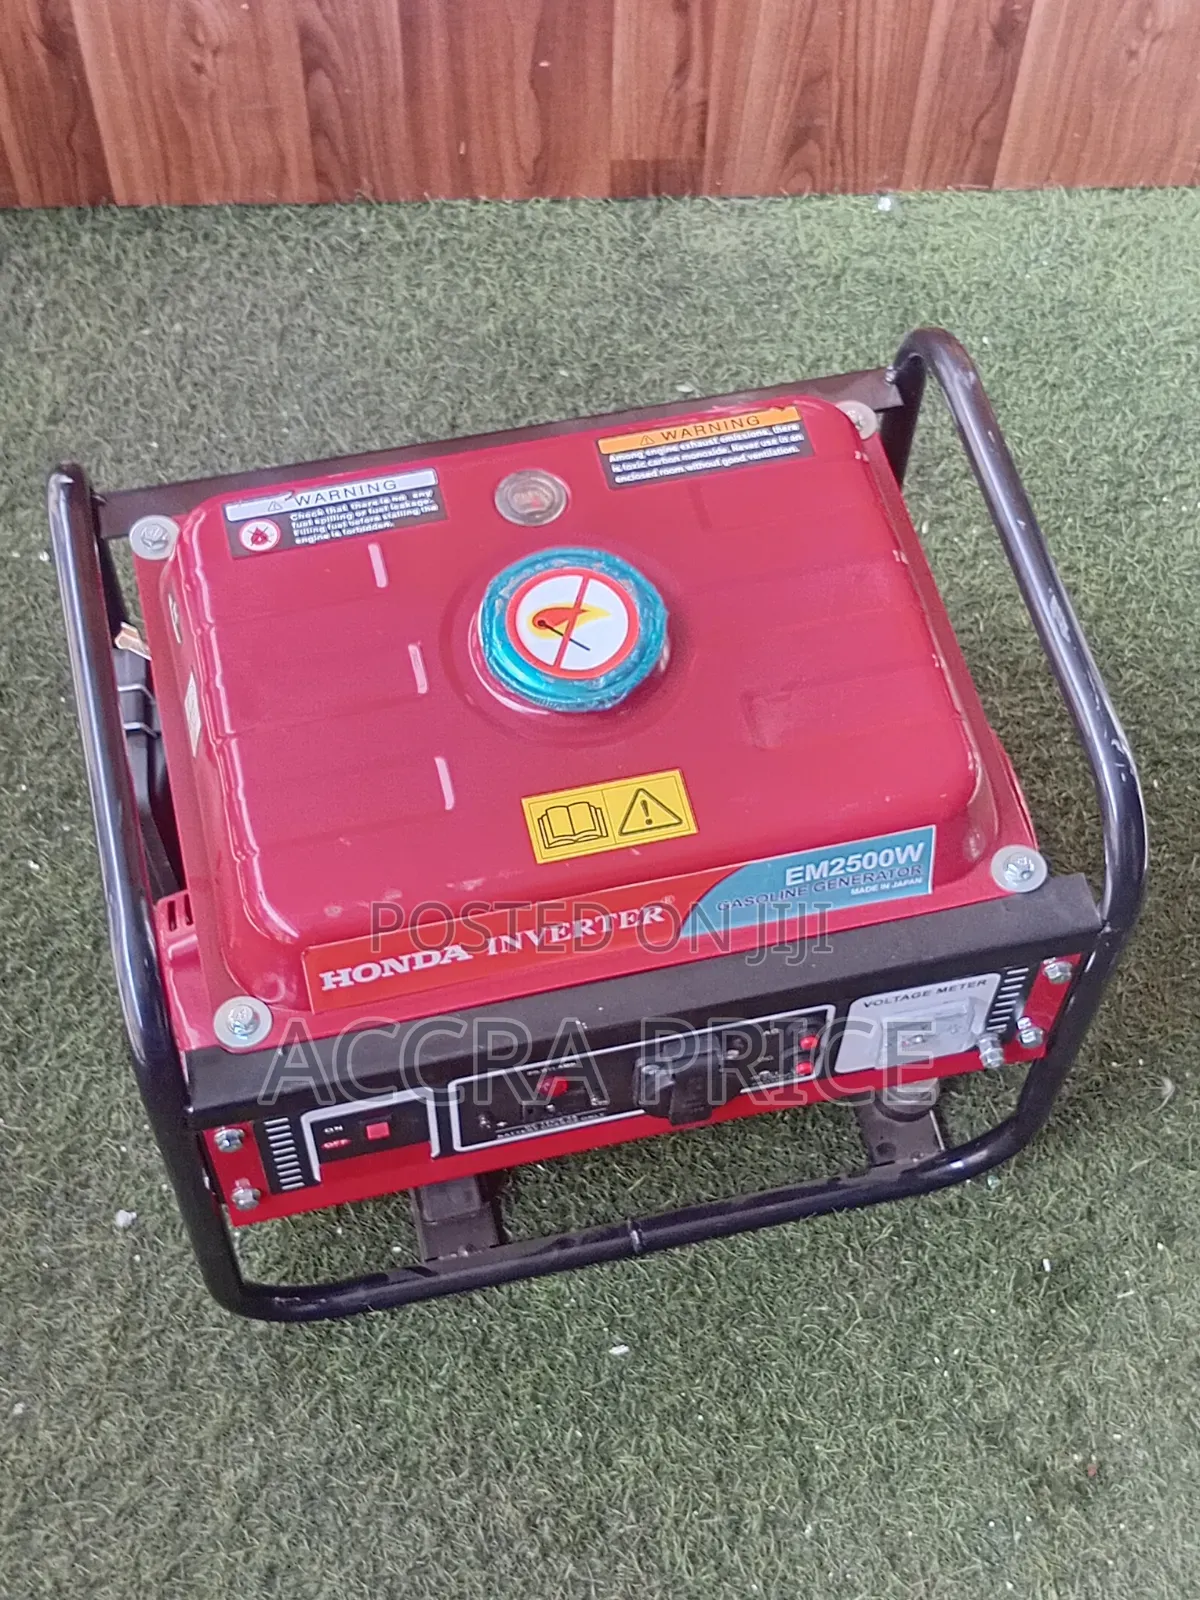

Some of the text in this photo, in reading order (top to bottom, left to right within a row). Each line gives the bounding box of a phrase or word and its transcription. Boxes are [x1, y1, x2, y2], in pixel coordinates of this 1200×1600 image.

[660, 415, 760, 441] WARNING
[609, 449, 645, 463] Among
[645, 445, 679, 458] engine
[680, 436, 719, 450] exhaust
[772, 423, 800, 434] there
[622, 460, 647, 471] toxic
[647, 455, 680, 467] carbon
[731, 442, 760, 452] Never
[615, 468, 659, 484] enclosed
[660, 466, 685, 476] room
[684, 456, 722, 471] without
[722, 453, 747, 467] good
[294, 479, 397, 506] WARNING
[325, 503, 349, 515] that
[350, 497, 379, 509] there
[785, 842, 925, 886] EM2500W
[717, 864, 923, 911] GASOLINE GENERATOR
[850, 876, 923, 896] MADE IN JAPAN
[319, 904, 666, 991] HONDA INVERTER
[863, 979, 988, 1008] VOLTAGE METER
[322, 1138, 351, 1149] OFF
[324, 1125, 344, 1135] ON
